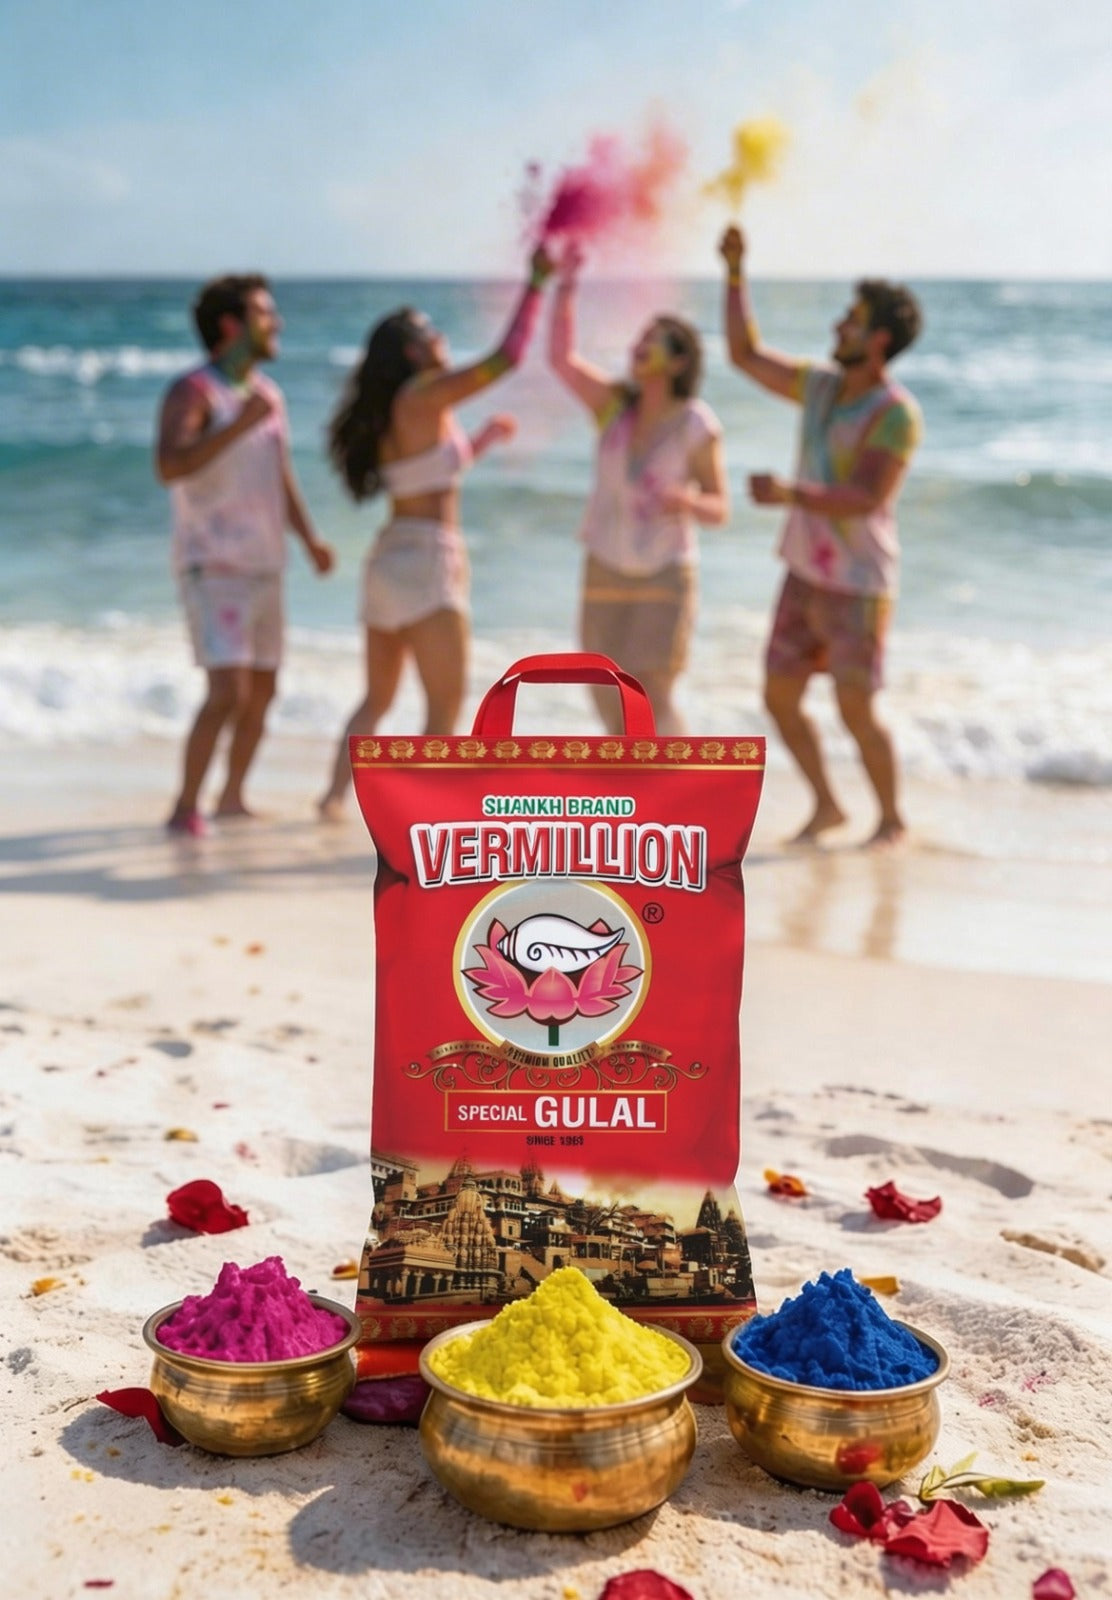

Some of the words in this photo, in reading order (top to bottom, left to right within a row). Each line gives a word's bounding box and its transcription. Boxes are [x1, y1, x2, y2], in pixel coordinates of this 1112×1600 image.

[483, 796, 563, 816] SHANKH
[566, 797, 635, 817] BRAND
[411, 822, 707, 891] VERMILLION
[458, 1104, 528, 1122] SPECIAL
[534, 1095, 657, 1128] GULAL
